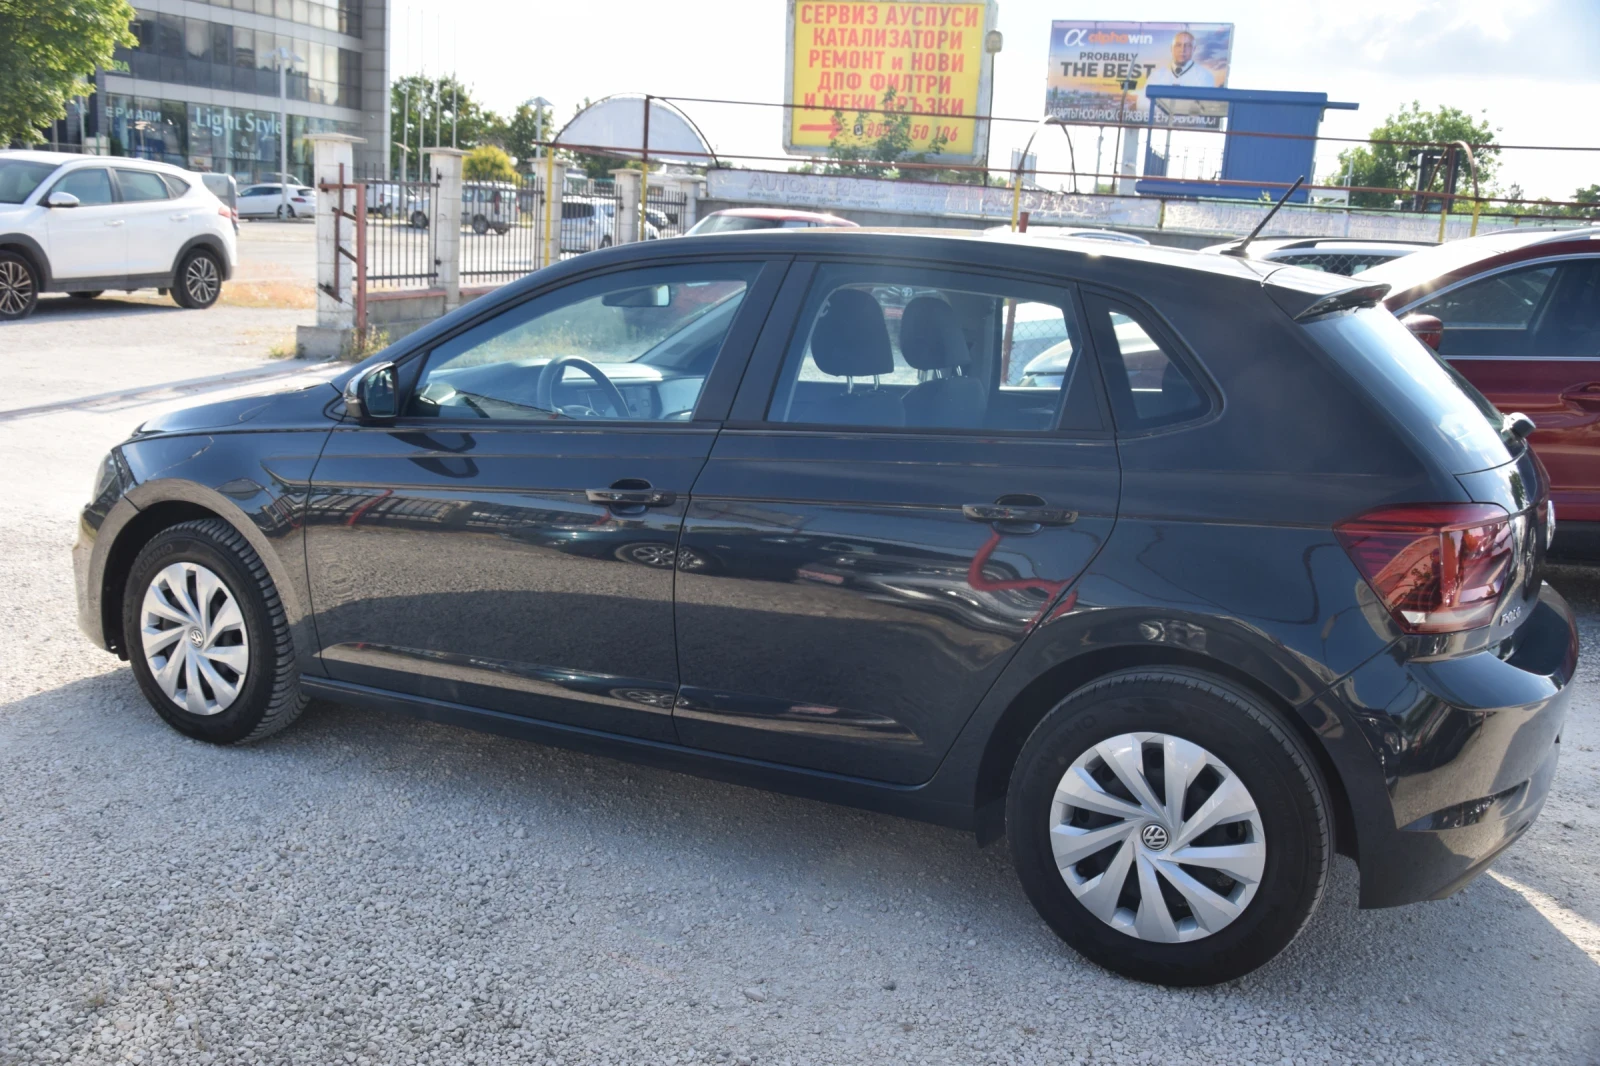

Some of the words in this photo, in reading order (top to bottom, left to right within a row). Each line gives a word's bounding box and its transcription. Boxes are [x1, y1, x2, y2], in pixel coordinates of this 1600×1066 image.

[801, 5, 878, 25] СЕРВИЗ
[885, 6, 979, 27] АУСПУСИ
[813, 28, 963, 50] КАТАЛИЗАТОРИ
[1088, 31, 1153, 45] alphawin
[809, 50, 885, 70] РЕМОНТ
[891, 57, 903, 70] и
[911, 53, 965, 73] НОВИ
[1079, 51, 1138, 62] PROBABLY
[1061, 62, 1098, 77] THE
[1103, 63, 1156, 79] BEST
[817, 72, 862, 93] ДПФ
[870, 74, 952, 95] ФИЛТРИ
[804, 94, 816, 112] И
[823, 94, 876, 113] МЕКИ
[196, 106, 242, 137] Light
[245, 112, 282, 141] Style
